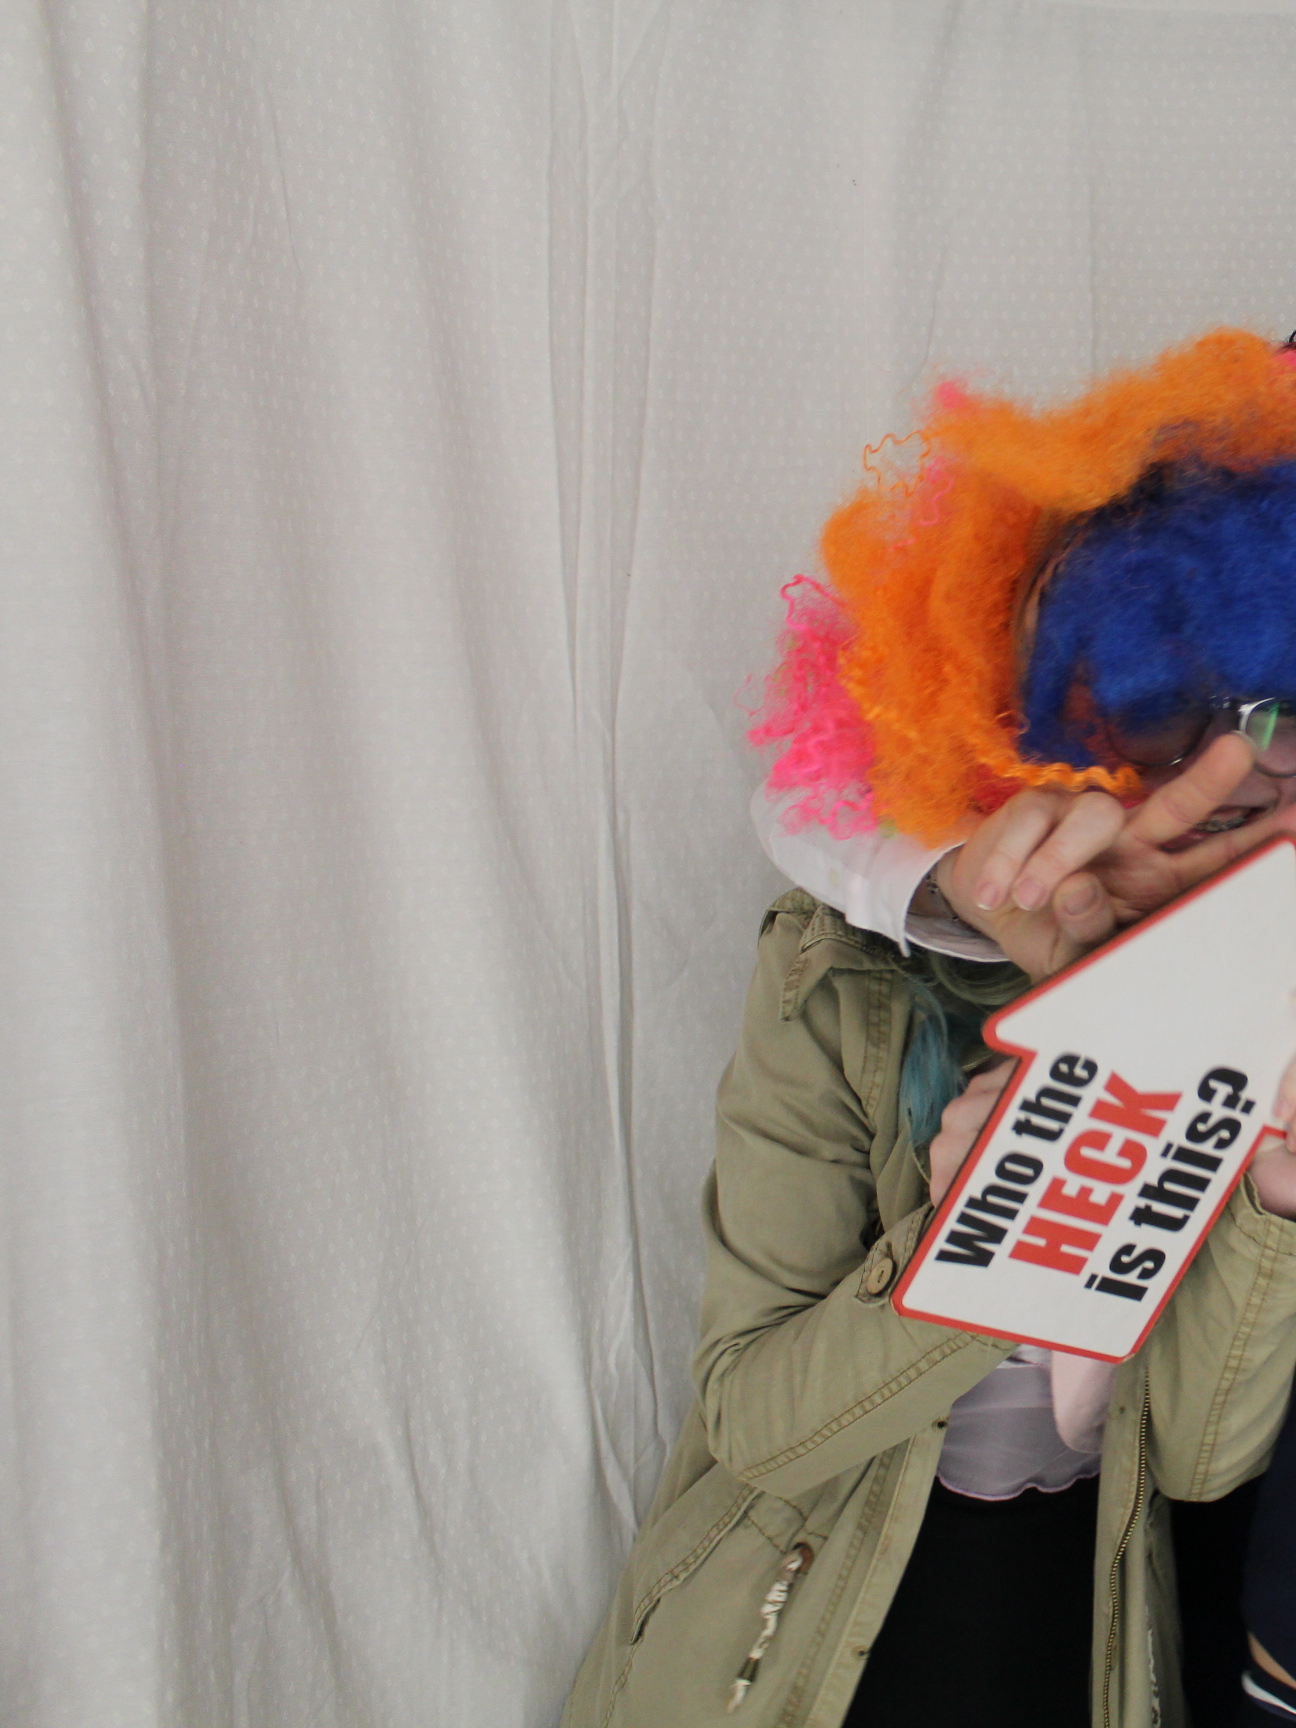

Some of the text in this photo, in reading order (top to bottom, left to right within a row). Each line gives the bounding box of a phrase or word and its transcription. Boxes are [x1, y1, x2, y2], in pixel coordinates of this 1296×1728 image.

[935, 1053, 1099, 1269] Who the
[1009, 1071, 1183, 1276] HECK
[1083, 1067, 1256, 1302] is this?
